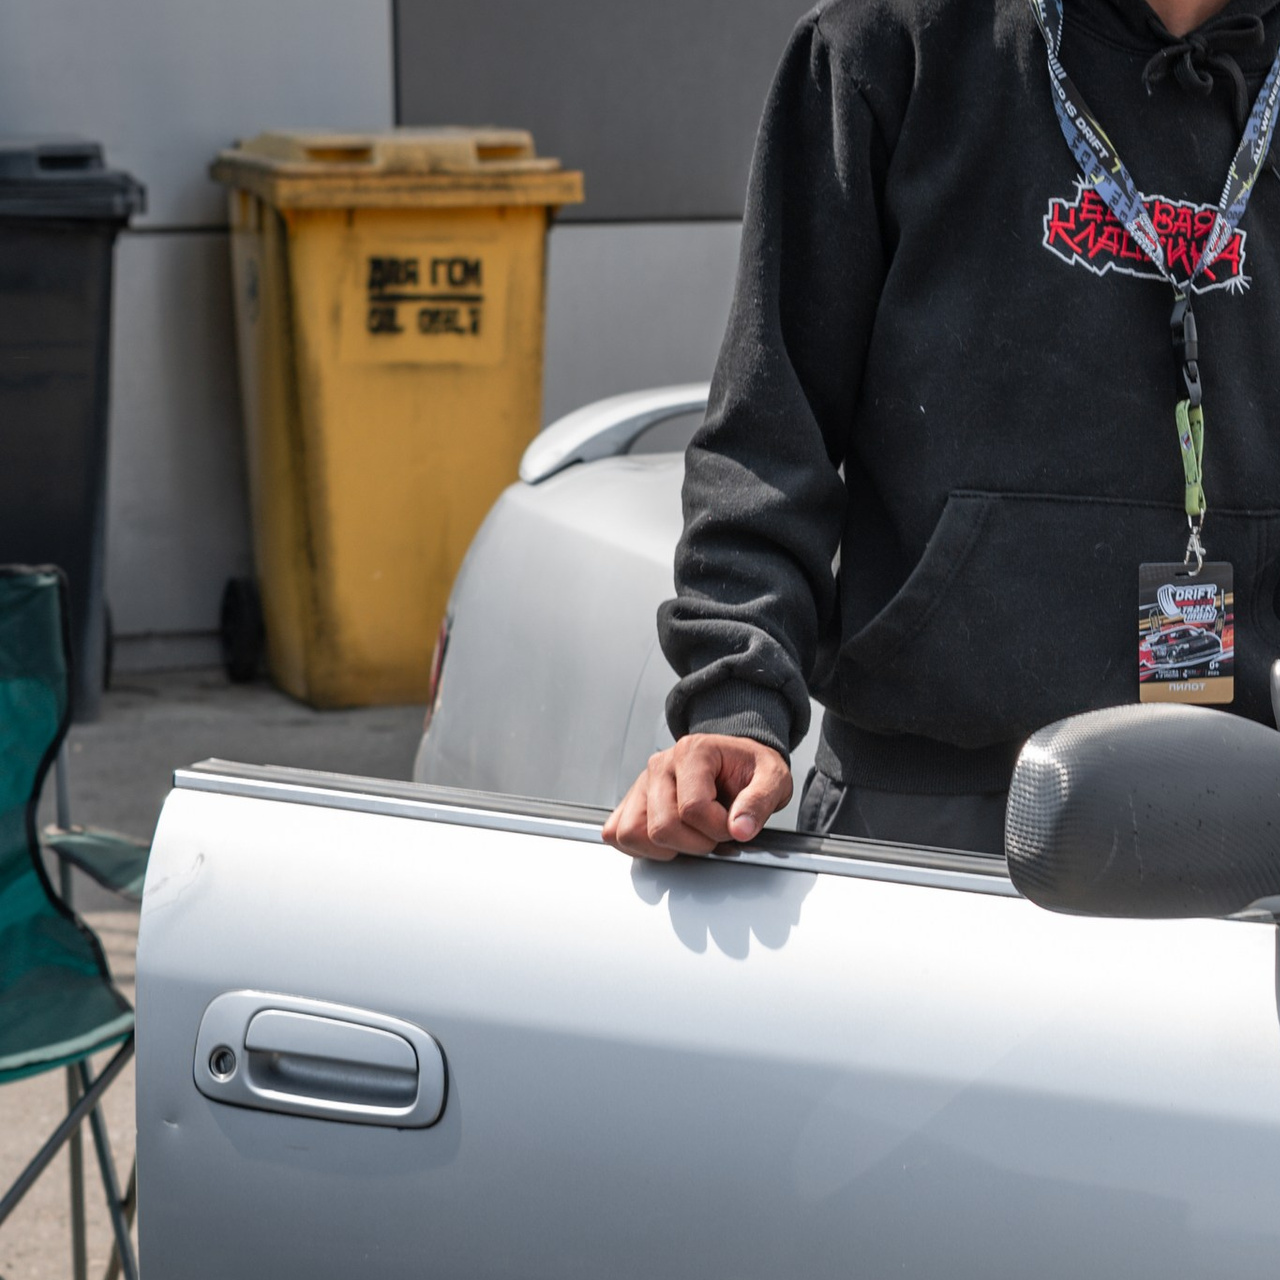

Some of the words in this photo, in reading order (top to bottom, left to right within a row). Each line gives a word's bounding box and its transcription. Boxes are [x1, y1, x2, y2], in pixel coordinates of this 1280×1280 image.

[1064, 100, 1078, 118] IS
[1075, 116, 1109, 159] DRIFT
[1260, 106, 1272, 132] WE
[1079, 189, 1217, 239] БВАЯ
[1049, 203, 1241, 282] КЛАСИКА
[1175, 586, 1214, 601] DRIFT
[1168, 682, 1206, 692] ПИЛОТ
